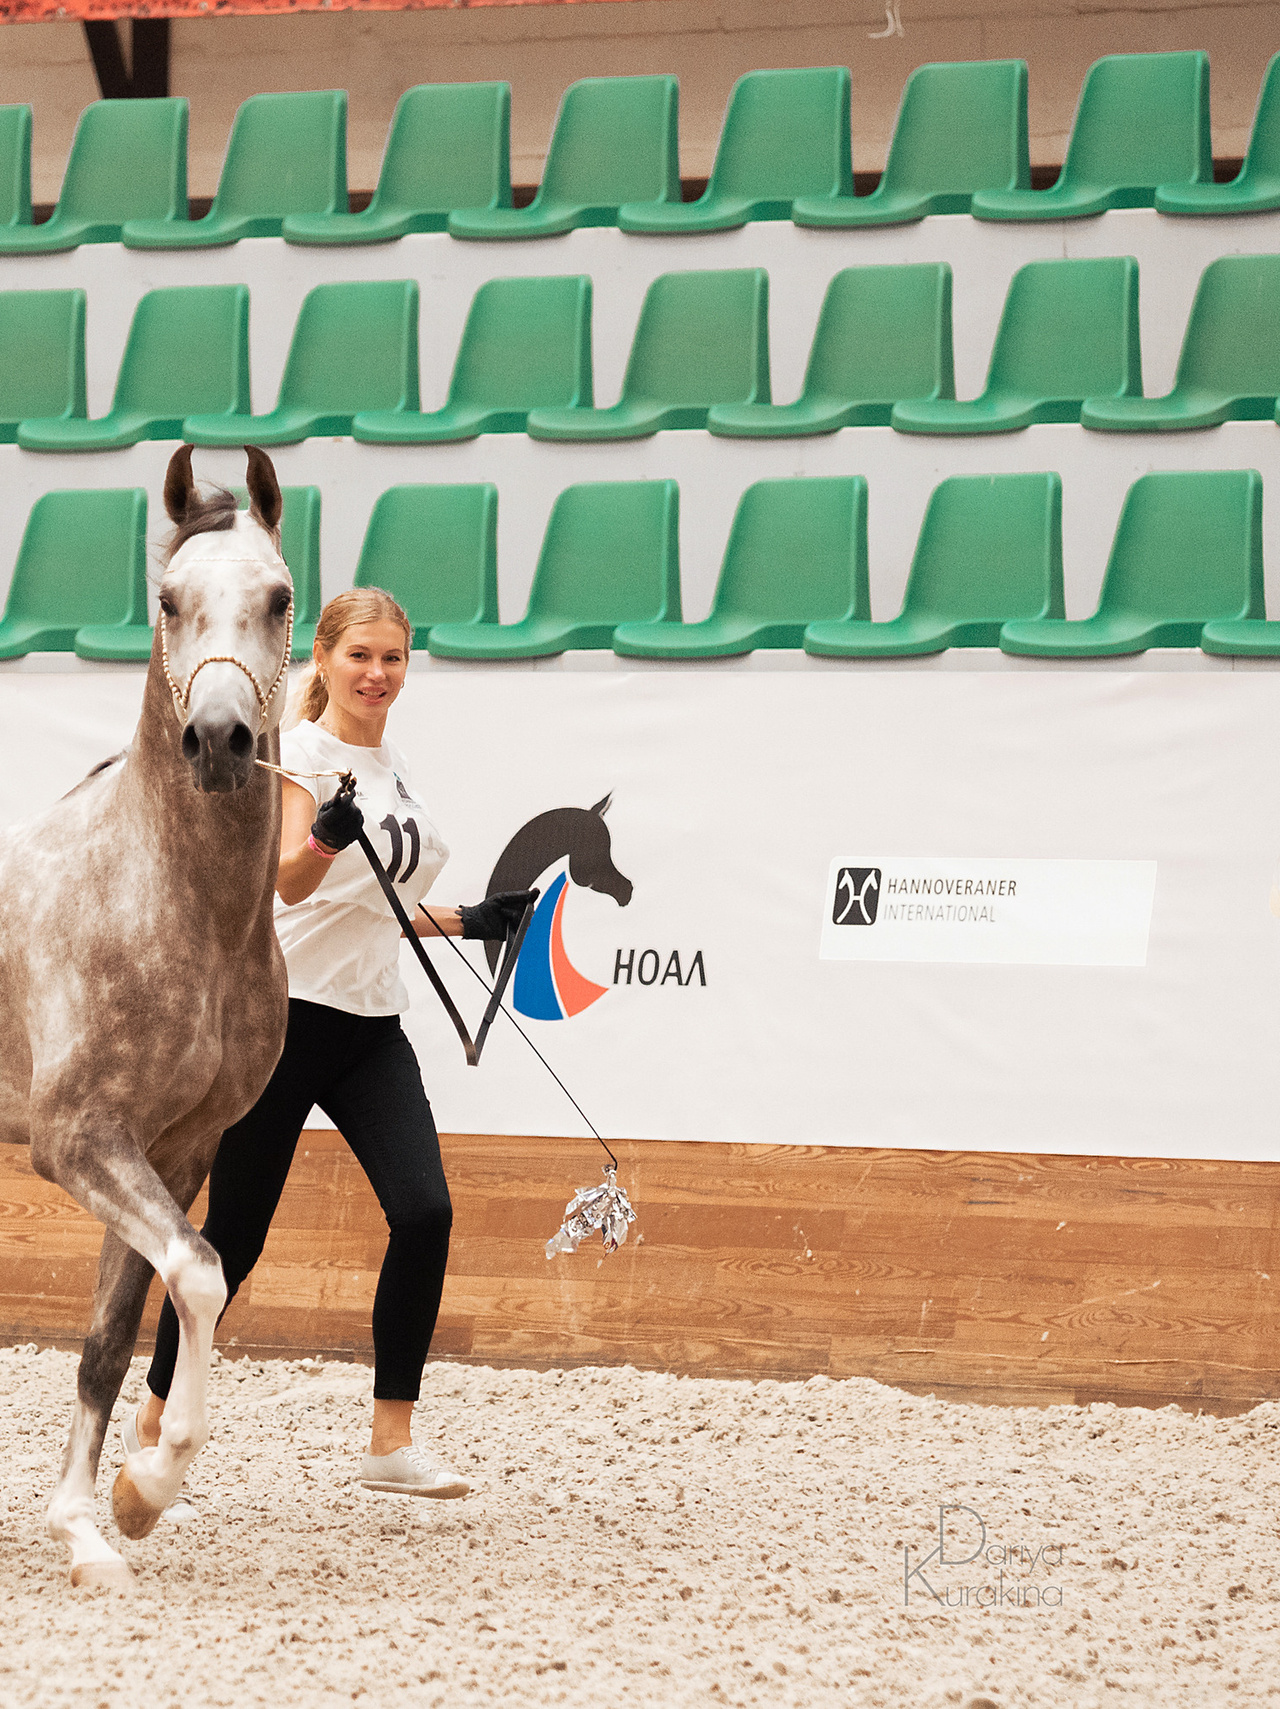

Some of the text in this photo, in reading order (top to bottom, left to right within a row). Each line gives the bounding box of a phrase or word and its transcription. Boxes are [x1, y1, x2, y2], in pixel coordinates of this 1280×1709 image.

[379, 814, 420, 883] 11
[887, 878, 1017, 897] HANNOVERANER
[883, 904, 997, 923] INTERNATIONAL
